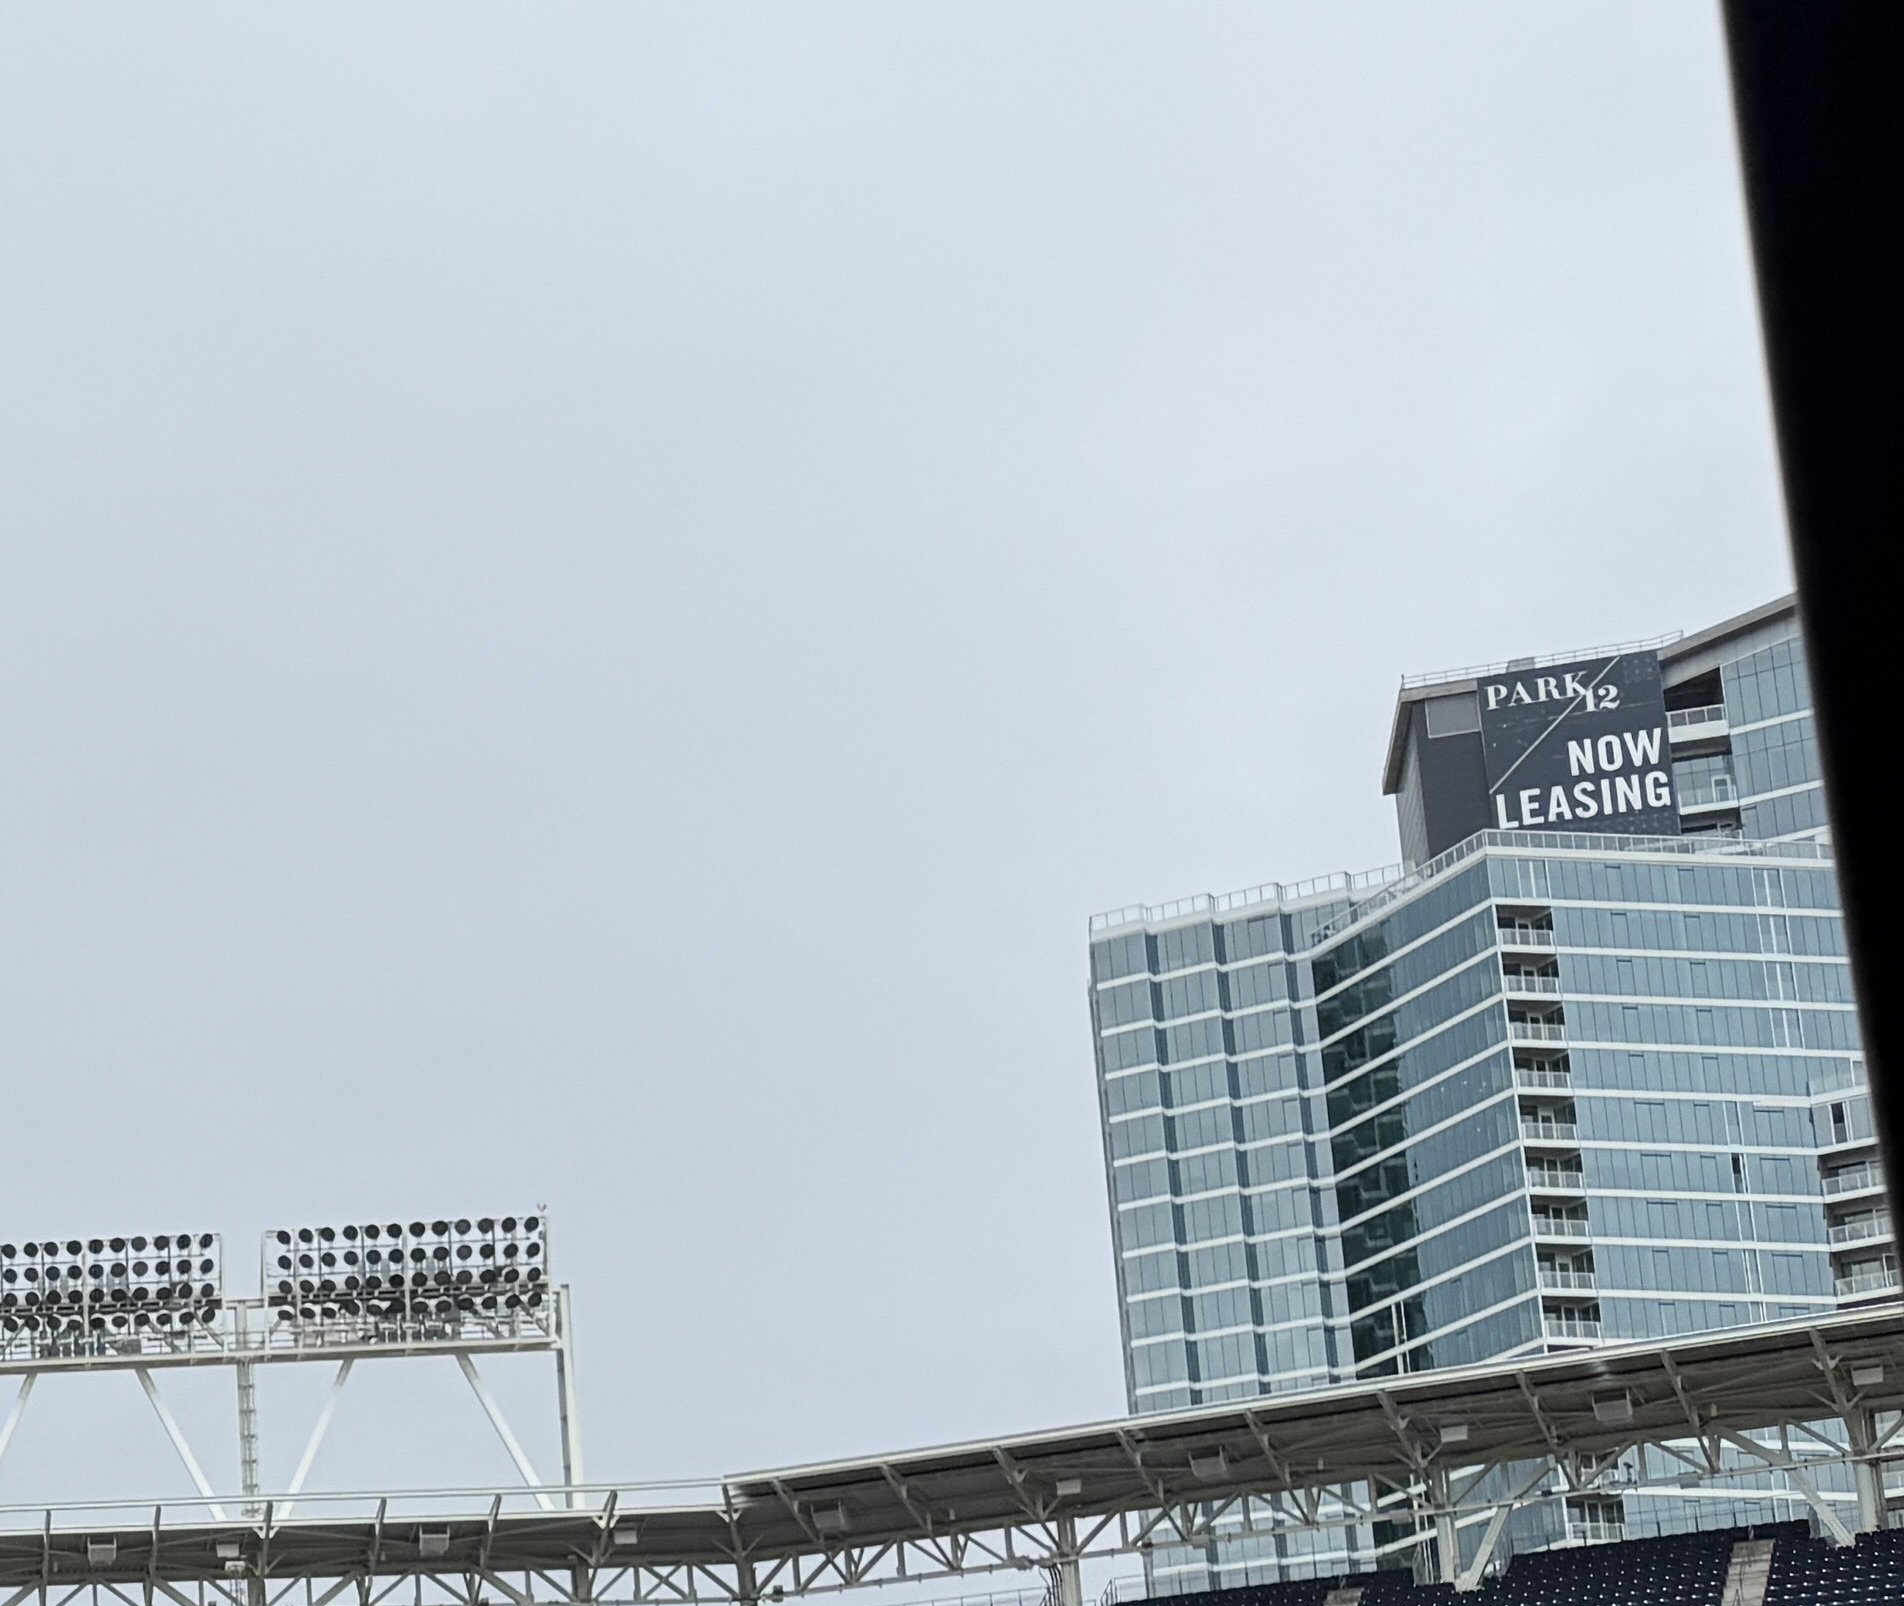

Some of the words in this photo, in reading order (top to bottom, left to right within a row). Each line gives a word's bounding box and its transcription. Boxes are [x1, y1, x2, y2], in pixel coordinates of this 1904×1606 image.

[1484, 670, 1589, 711] PARK
[1582, 684, 1621, 712] 12
[1567, 727, 1662, 776] NOW
[1495, 770, 1671, 829] LEASING
